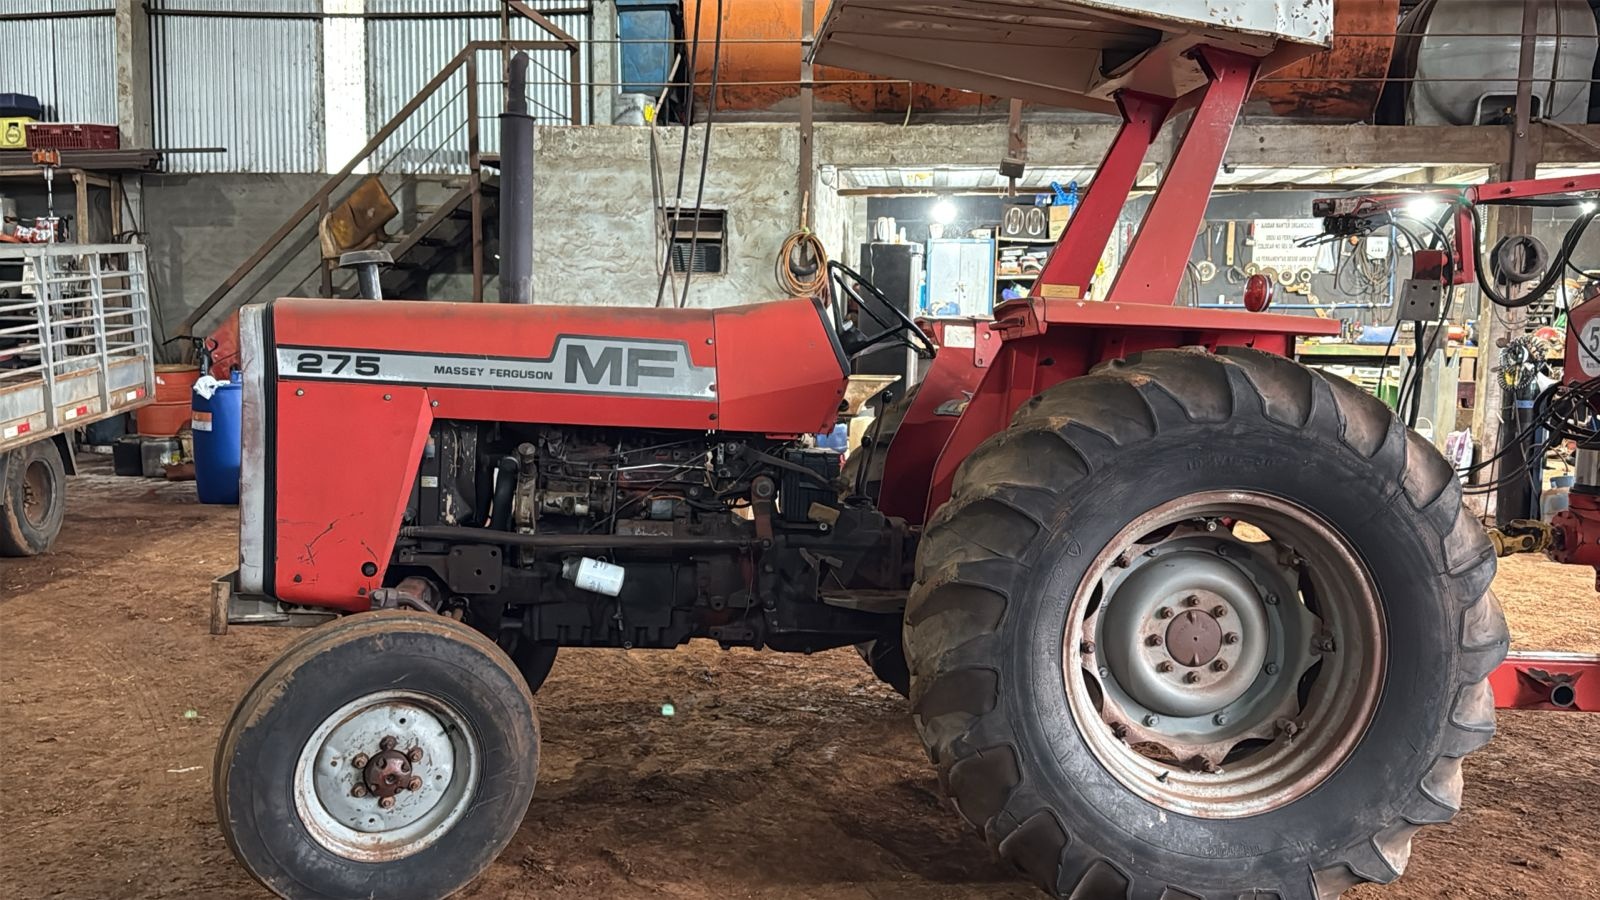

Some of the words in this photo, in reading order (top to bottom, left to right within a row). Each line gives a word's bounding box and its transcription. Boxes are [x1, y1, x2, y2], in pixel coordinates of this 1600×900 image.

[297, 353, 381, 377] 275
[433, 365, 484, 376] MASSEY
[489, 367, 553, 380] FERGUSON
[564, 344, 678, 387] MF
